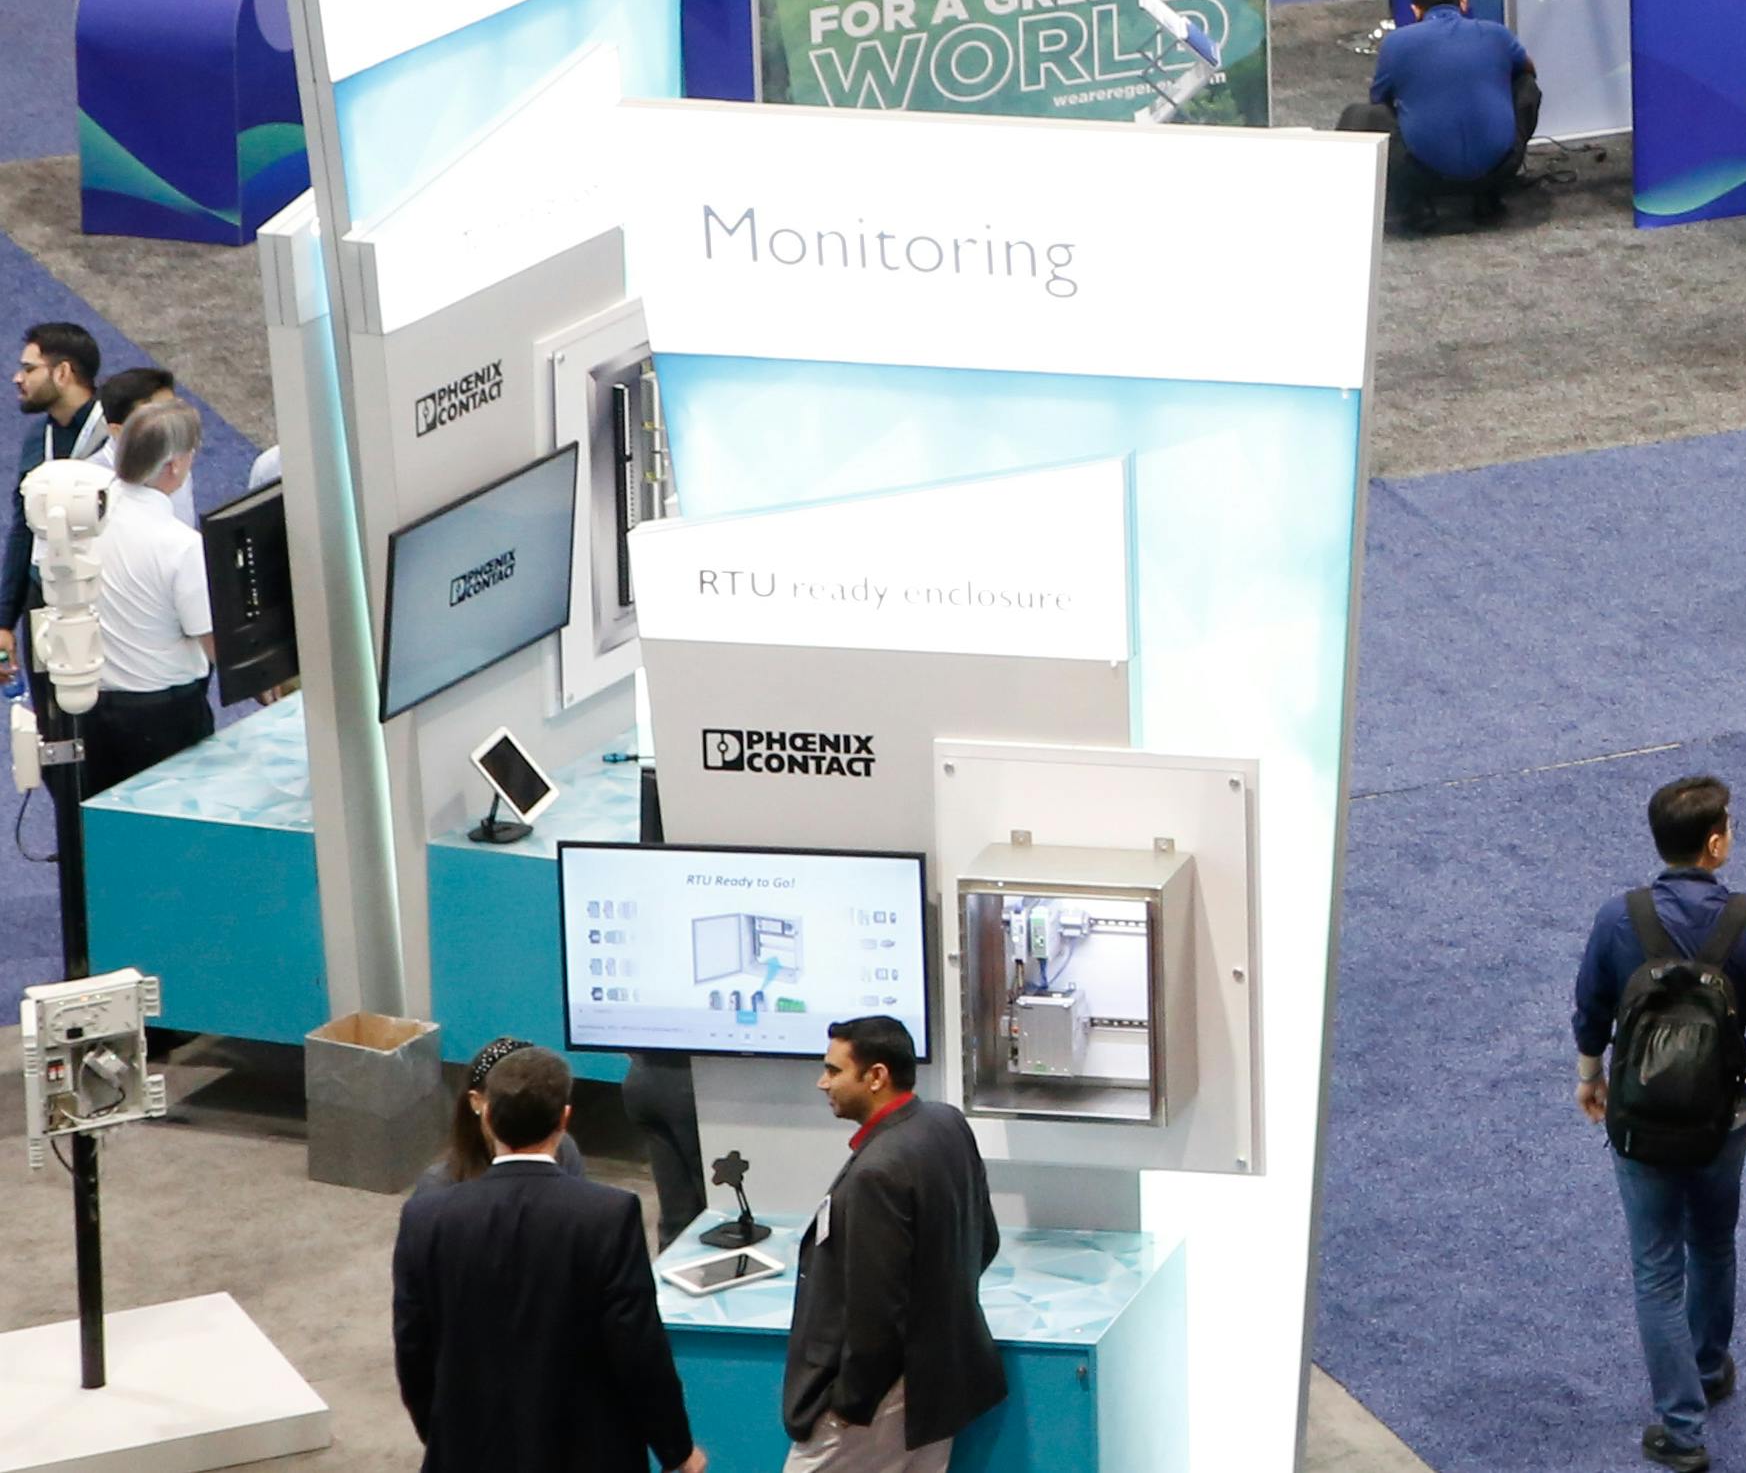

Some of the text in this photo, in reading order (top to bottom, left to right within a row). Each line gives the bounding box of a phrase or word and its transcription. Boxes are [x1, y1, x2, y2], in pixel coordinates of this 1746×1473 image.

[702, 203, 1078, 299] Monitoring
[436, 381, 503, 426] CONTACT
[465, 566, 516, 601] CONTACT
[699, 569, 1073, 613] RTU ready enclosure
[746, 752, 876, 778] CONTACT
[686, 874, 796, 892] RTU Ready to Go!
